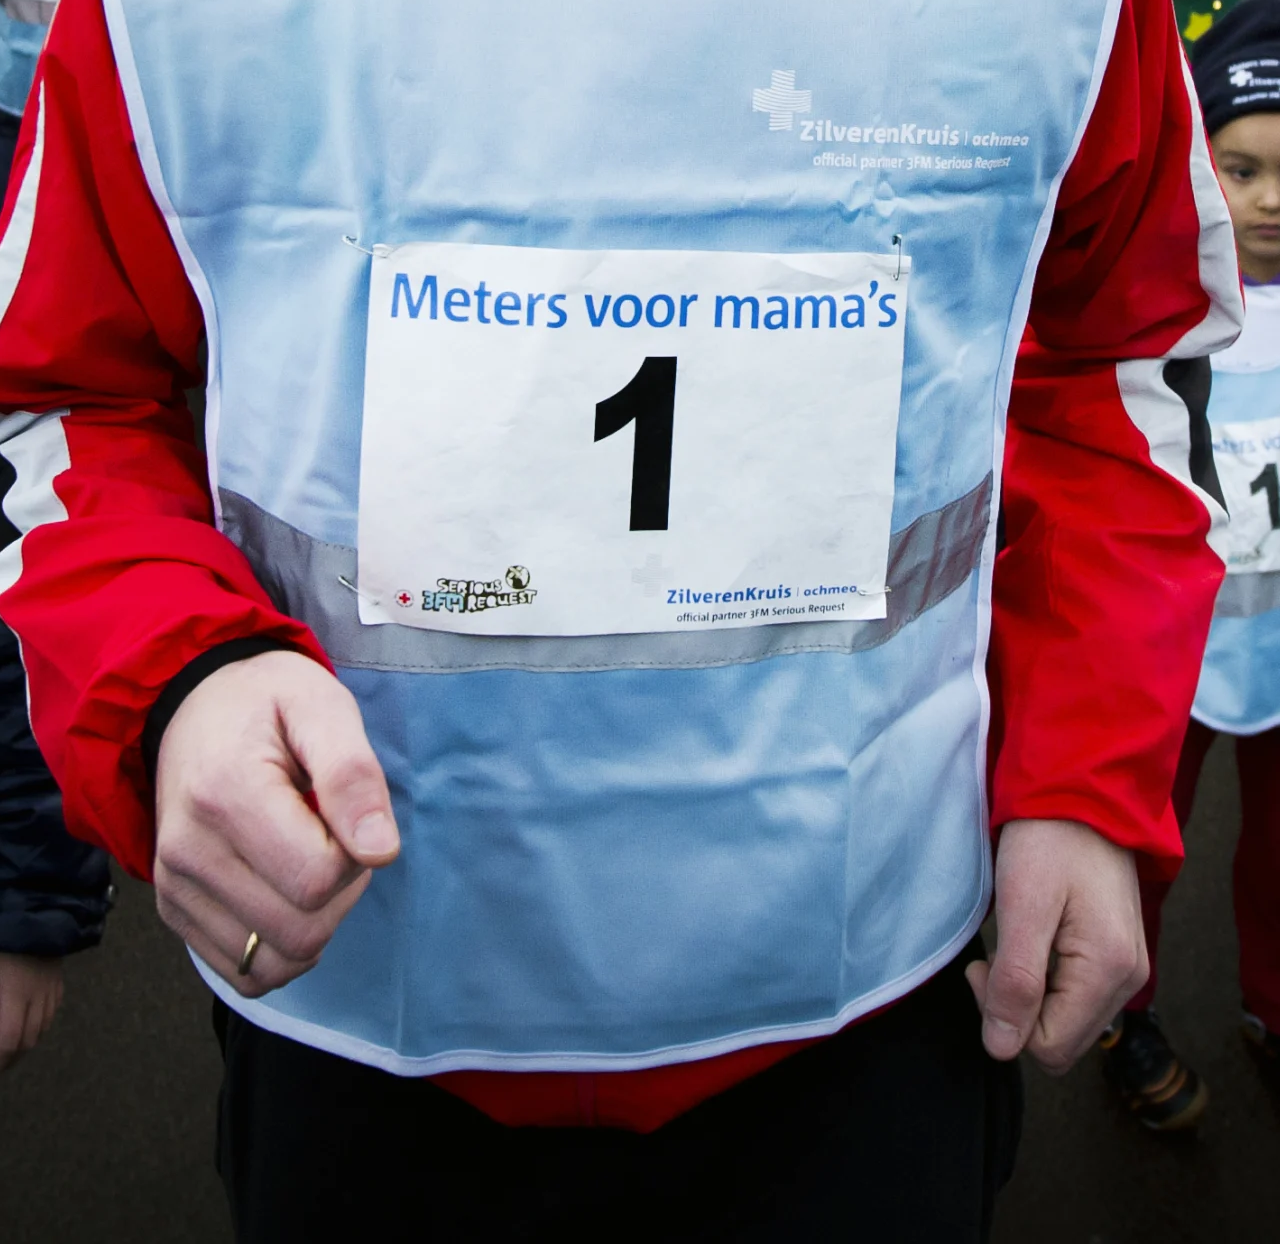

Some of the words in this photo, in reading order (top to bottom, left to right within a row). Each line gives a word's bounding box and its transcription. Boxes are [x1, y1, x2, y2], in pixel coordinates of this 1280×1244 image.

[799, 120, 960, 146] ZilverenKruis
[972, 131, 1030, 147] achmea
[813, 152, 857, 168] official
[860, 155, 904, 171] partner
[906, 157, 932, 171] 3FM
[935, 158, 974, 170] Serious
[974, 156, 1012, 172] Request
[390, 272, 568, 329] Meters
[586, 292, 698, 328] voor
[714, 280, 897, 330] mama's
[594, 356, 677, 531] 1
[1212, 438, 1256, 454] eters
[437, 578, 503, 596] SERIOUS
[667, 584, 792, 604] ZilverenKruis
[803, 584, 857, 597] achmea
[422, 590, 466, 613] 3FM
[466, 589, 538, 613] REQUEST
[676, 611, 710, 623] official
[711, 610, 747, 623] partner
[749, 608, 769, 620] 3FM
[771, 604, 806, 616] Serious
[808, 602, 846, 615] Request
